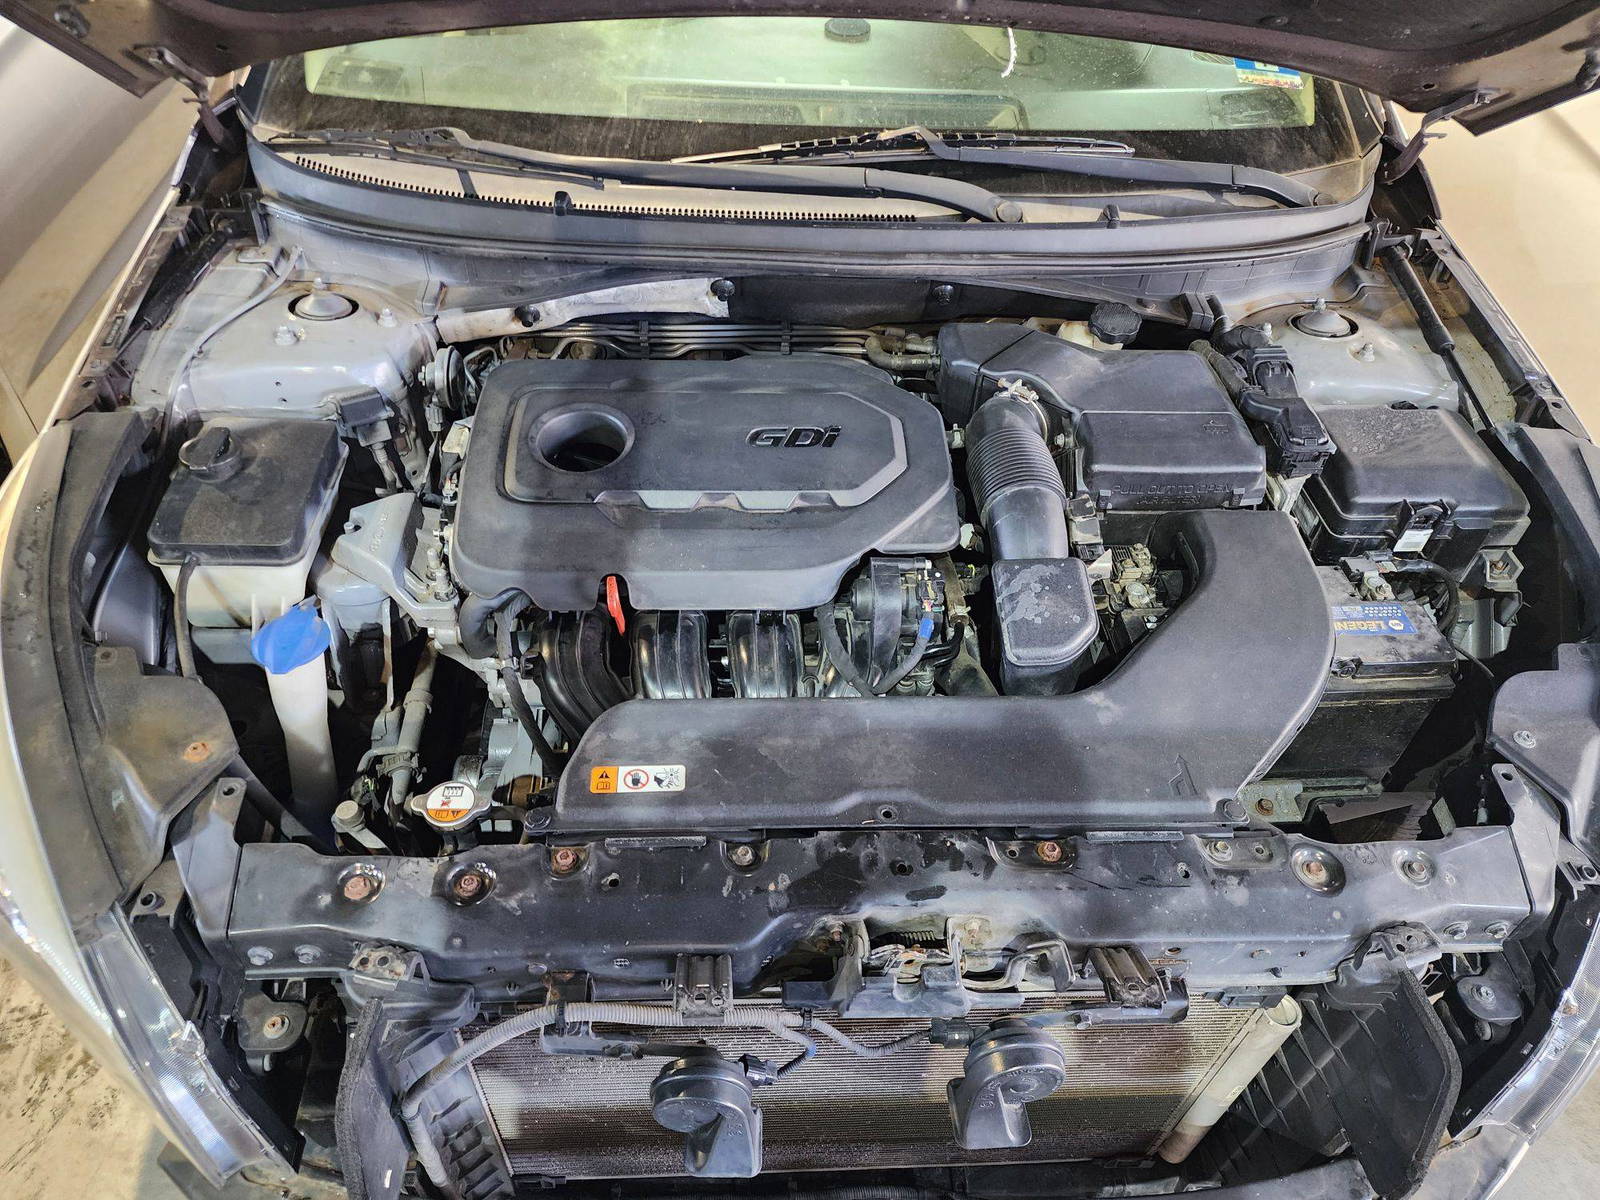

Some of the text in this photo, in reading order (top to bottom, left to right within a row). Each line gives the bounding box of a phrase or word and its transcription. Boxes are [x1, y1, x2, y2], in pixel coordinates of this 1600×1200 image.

[745, 424, 842, 448] GDi
[1111, 483, 1233, 496] PULL OUT TO OPEN
